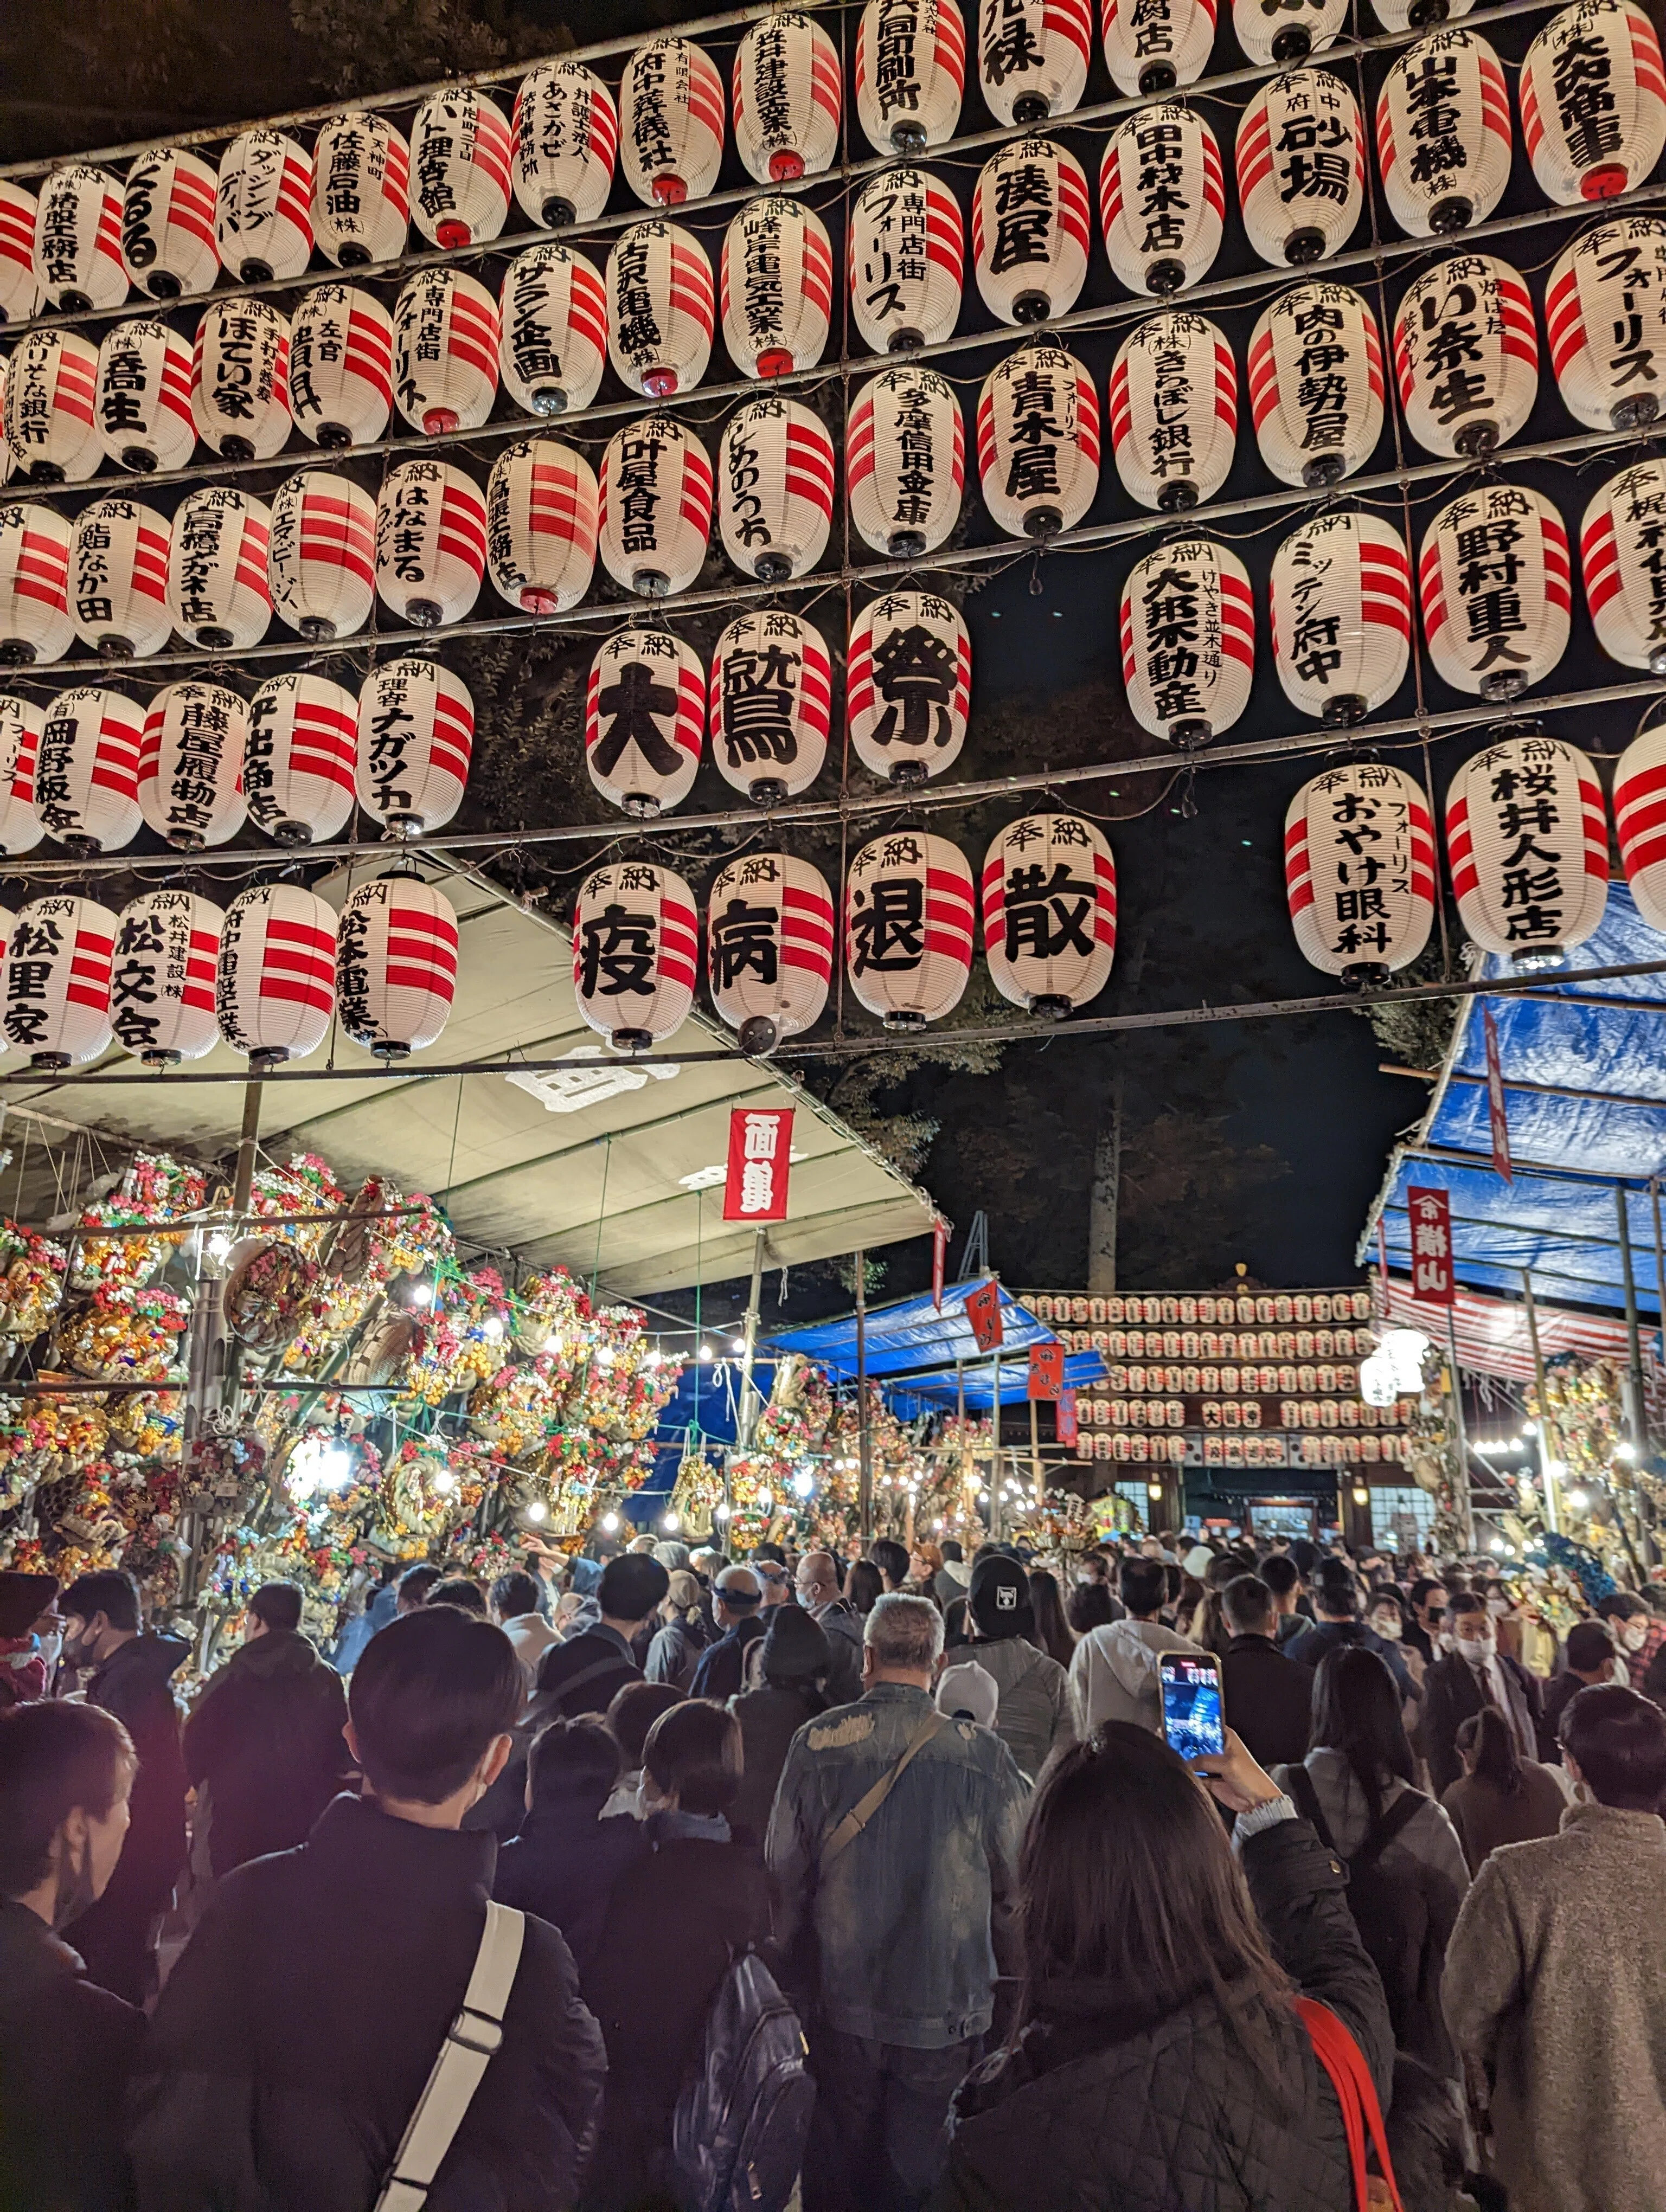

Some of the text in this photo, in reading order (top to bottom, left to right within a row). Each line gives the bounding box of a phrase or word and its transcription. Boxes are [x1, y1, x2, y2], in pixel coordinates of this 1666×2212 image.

[539, 81, 567, 158] あさかぜ
[632, 52, 677, 172] 府中葬儀社
[674, 52, 690, 105] 有限会社
[1268, 70, 1349, 95] 奉納
[1285, 93, 1342, 112] 府中
[367, 137, 386, 181] 天神町
[418, 105, 457, 219] ハト理容館
[519, 91, 539, 183] 法律事務所
[571, 87, 592, 164] 弁護士法人
[984, 140, 1058, 175] 奉納
[1275, 115, 1354, 206] 砂場
[123, 164, 161, 269] くるる
[219, 170, 247, 242] ディバ
[244, 149, 282, 230] ダッシング
[864, 193, 906, 320] フォーリス
[896, 192, 927, 281] 専門店街
[317, 320, 343, 362] 左官
[414, 285, 446, 362] 専門店街
[1127, 312, 1210, 348] 奉納
[1271, 284, 1359, 318] 奉納
[1477, 279, 1508, 335] 炉ばた
[1595, 246, 1659, 387] フォーリス
[19, 348, 51, 444] りそな銀行
[212, 318, 259, 420] ほてい家
[1293, 304, 1350, 452] 肉の伊勢屋
[375, 502, 393, 574] うどん
[393, 486, 429, 582] はなまる
[616, 438, 668, 555] 叶屋食品
[1437, 488, 1535, 532] 奉納
[75, 523, 113, 623] 鮨なか田
[873, 593, 956, 623] 奉納
[1291, 542, 1343, 685] ミッテン府中
[1456, 519, 1532, 671] 野村重人
[603, 629, 680, 660] 奉納
[725, 612, 803, 644] 奉納
[1142, 568, 1207, 721] 大邦不動産
[1201, 569, 1223, 688] けやき並木通り
[172, 684, 244, 716] 奉納
[590, 661, 684, 778] 大
[722, 644, 803, 769] 鷲
[871, 623, 959, 748] 祭
[369, 678, 416, 811] 理容ナガツカ
[1311, 766, 1403, 795] 奉納
[1470, 740, 1572, 774] 奉納
[713, 857, 781, 898] 奉納
[853, 836, 924, 877] 奉納
[1005, 818, 1093, 853] 奉納
[1332, 792, 1393, 954] おやけ眼科
[1386, 802, 1411, 895] フォーリス
[1490, 763, 1565, 941] 桜井人形店
[584, 865, 661, 900] 奉納
[1003, 863, 1099, 963] 散
[579, 903, 657, 999] 疫
[709, 898, 780, 996] 病
[851, 878, 925, 979] 退
[3, 918, 65, 1045] 松里家
